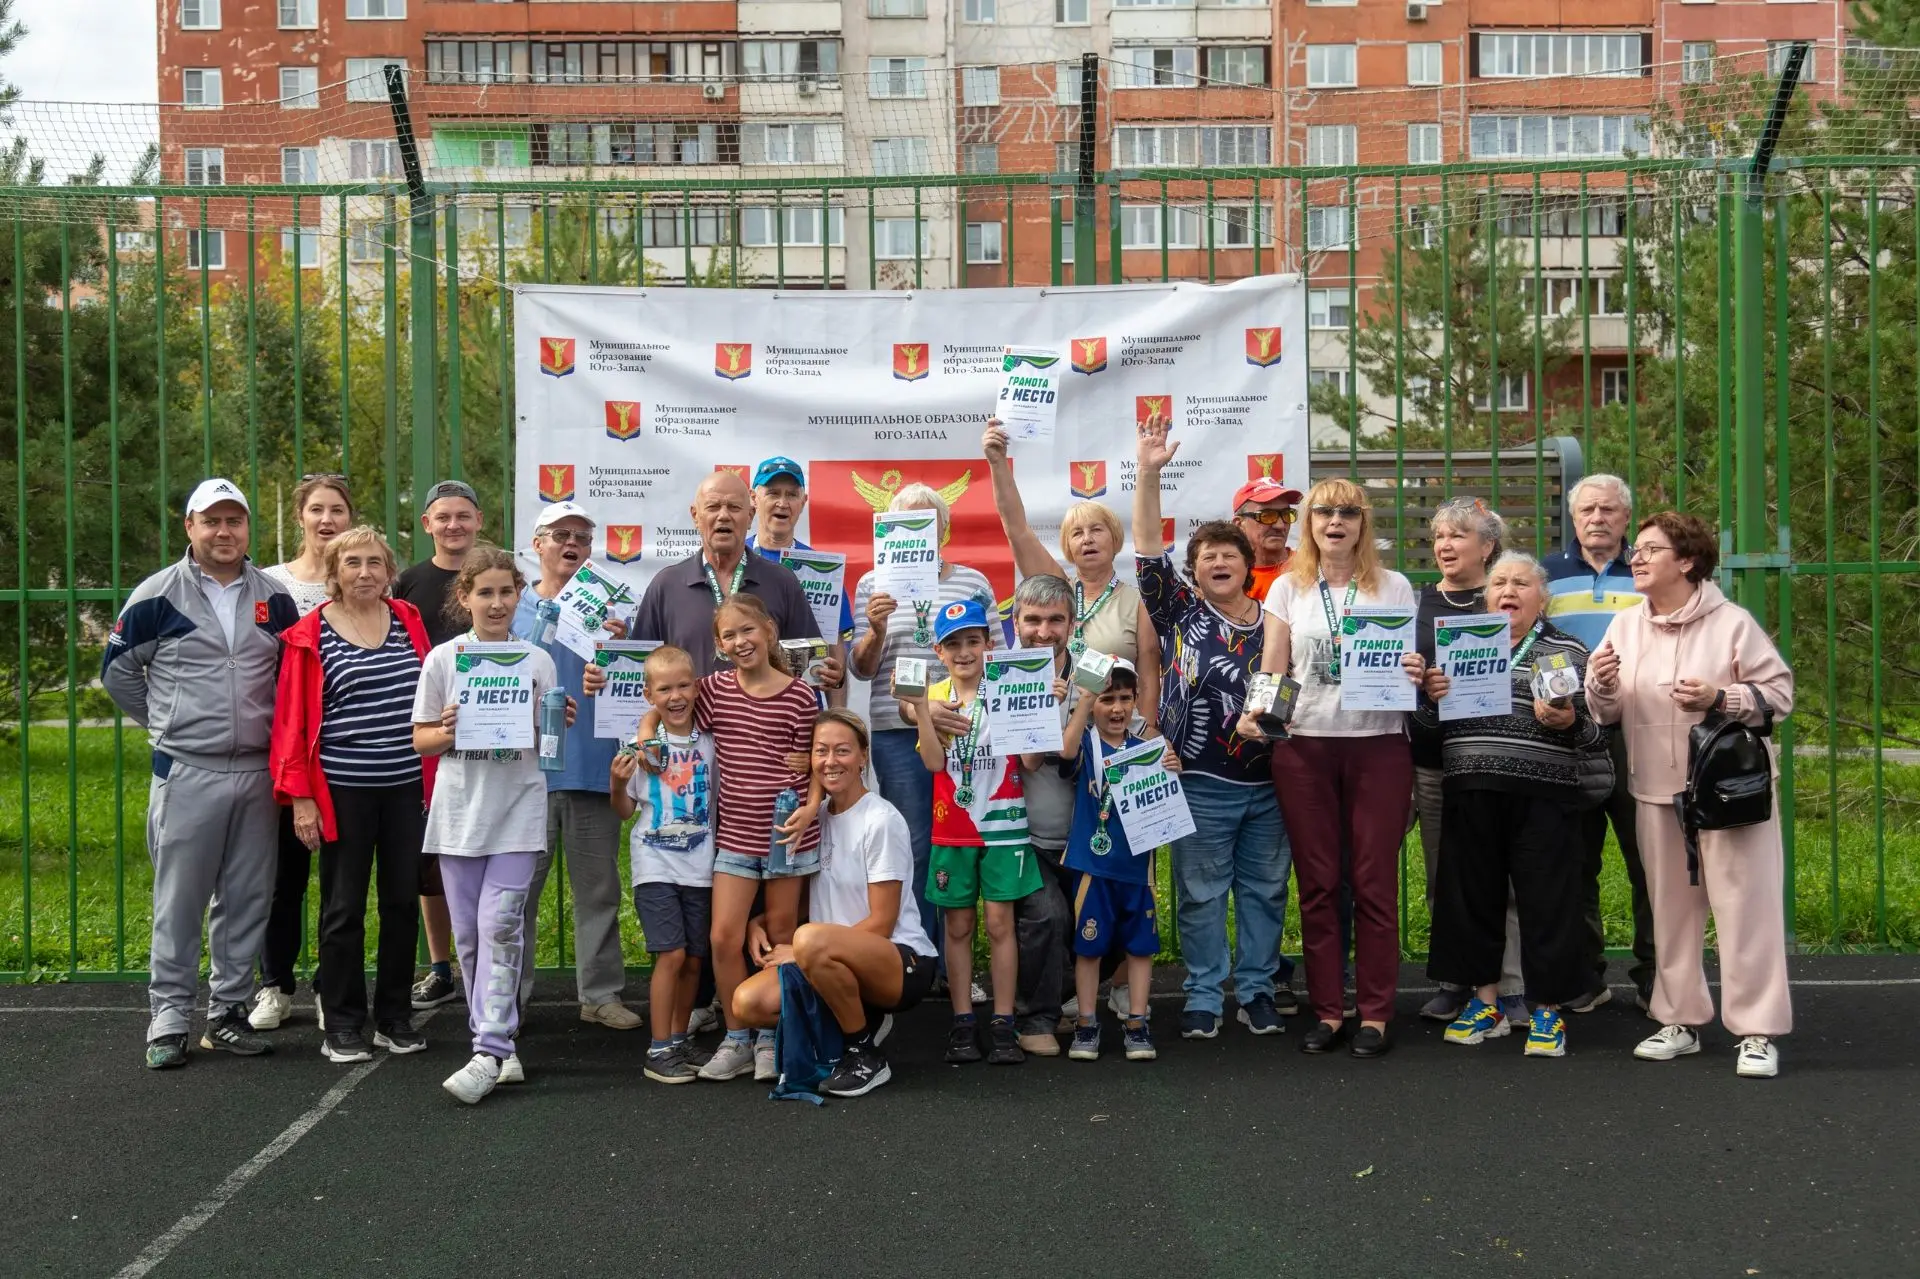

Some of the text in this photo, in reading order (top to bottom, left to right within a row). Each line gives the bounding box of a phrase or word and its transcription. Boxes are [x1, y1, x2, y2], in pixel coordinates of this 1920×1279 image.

[589, 340, 671, 353] Муниципальное
[1121, 335, 1201, 348] Муниципальное
[766, 345, 848, 358] Муниципальное
[943, 344, 1005, 357] Муниципал
[1121, 346, 1183, 357] образование
[589, 352, 652, 363] образование
[766, 357, 830, 368] образование
[943, 357, 1002, 366] образовани
[1121, 357, 1175, 366] Юго-Запад
[590, 363, 646, 373] Юго-Запад
[766, 367, 822, 376] Юго-Запад
[944, 366, 1000, 375] Юго-Запад
[1008, 376, 1049, 388] ГРАМОТА
[999, 388, 1056, 404] 2 МЕСТО
[1186, 395, 1268, 408] Муниципальное
[655, 404, 737, 417] Муниципальное
[1186, 407, 1251, 416] образование
[655, 415, 720, 426] образование
[808, 415, 922, 426] МУНИЦИПАЛЬНОЕ
[1186, 417, 1243, 426] Юго-Запад
[655, 425, 712, 436] Юго-Запад
[874, 430, 948, 441] ЮГО-ЗАПАД
[589, 466, 670, 479] Муниципальное
[589, 478, 653, 488] образование
[589, 489, 645, 499] Юго-Запад
[884, 539, 927, 550] ГРАМОТА
[877, 550, 935, 564] 3 МЕСТО
[801, 580, 832, 591] АМОТА
[560, 592, 573, 602] 3
[806, 592, 839, 607] ЕСТО
[1354, 640, 1404, 650] ГРАМОТА
[1344, 652, 1408, 667] 1 МЕСТ
[1449, 648, 1499, 661] ГРАМОТА
[1453, 659, 1508, 677] МЕСТО
[468, 677, 520, 687] ГРАМОТА
[998, 682, 1046, 695] ГРАМОТА
[459, 689, 530, 704] 3 МЕСТО
[991, 694, 1055, 712] 2 МЕСТО
[465, 751, 490, 760] FREAK
[672, 749, 704, 764] IVA
[692, 764, 709, 775] LA
[974, 759, 996, 771] ETTER
[1123, 771, 1168, 796] ГРАМОТА
[1120, 799, 1131, 814] 2
[1135, 780, 1179, 809] МЕСТО
[1014, 851, 1024, 878] 7
